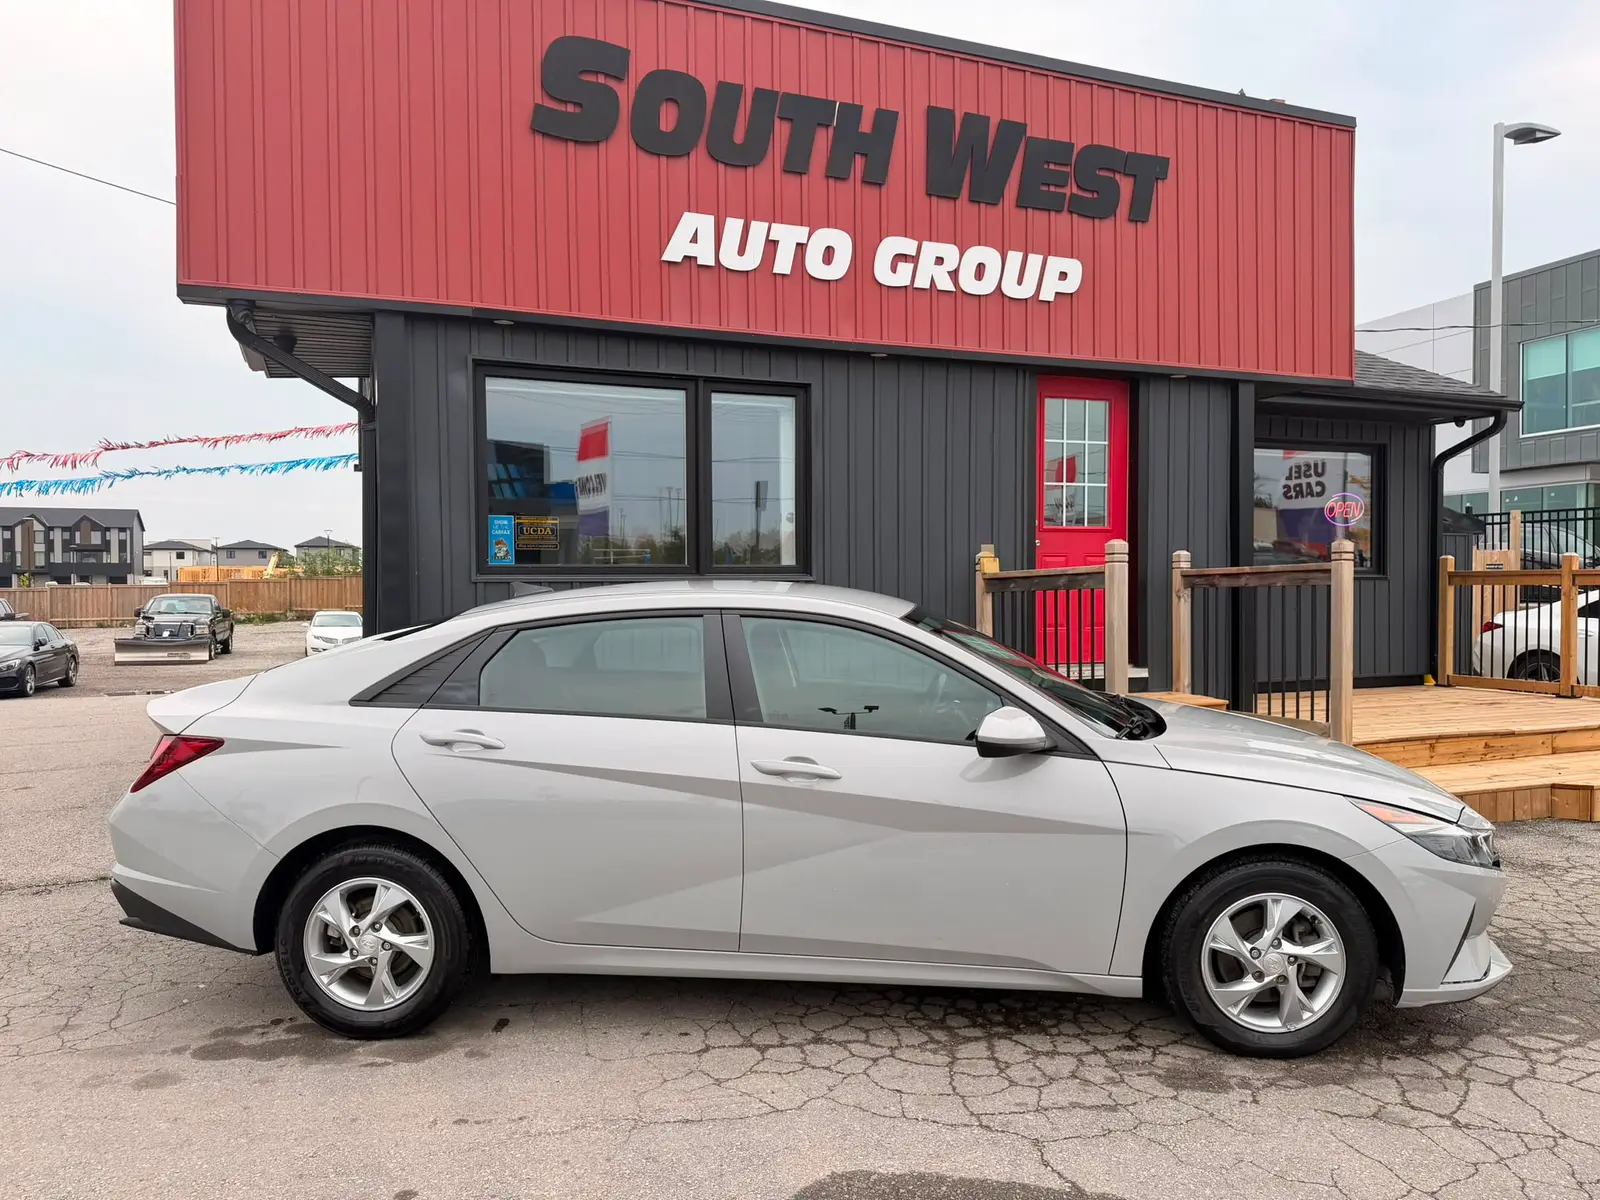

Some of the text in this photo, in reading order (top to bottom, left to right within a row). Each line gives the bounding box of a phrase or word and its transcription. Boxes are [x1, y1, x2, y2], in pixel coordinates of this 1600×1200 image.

[530, 35, 1170, 223] SOUTH WEST
[661, 211, 1082, 302] AUTO GROUP
[523, 527, 552, 535] UCDA
[1326, 502, 1361, 518] OPEN
